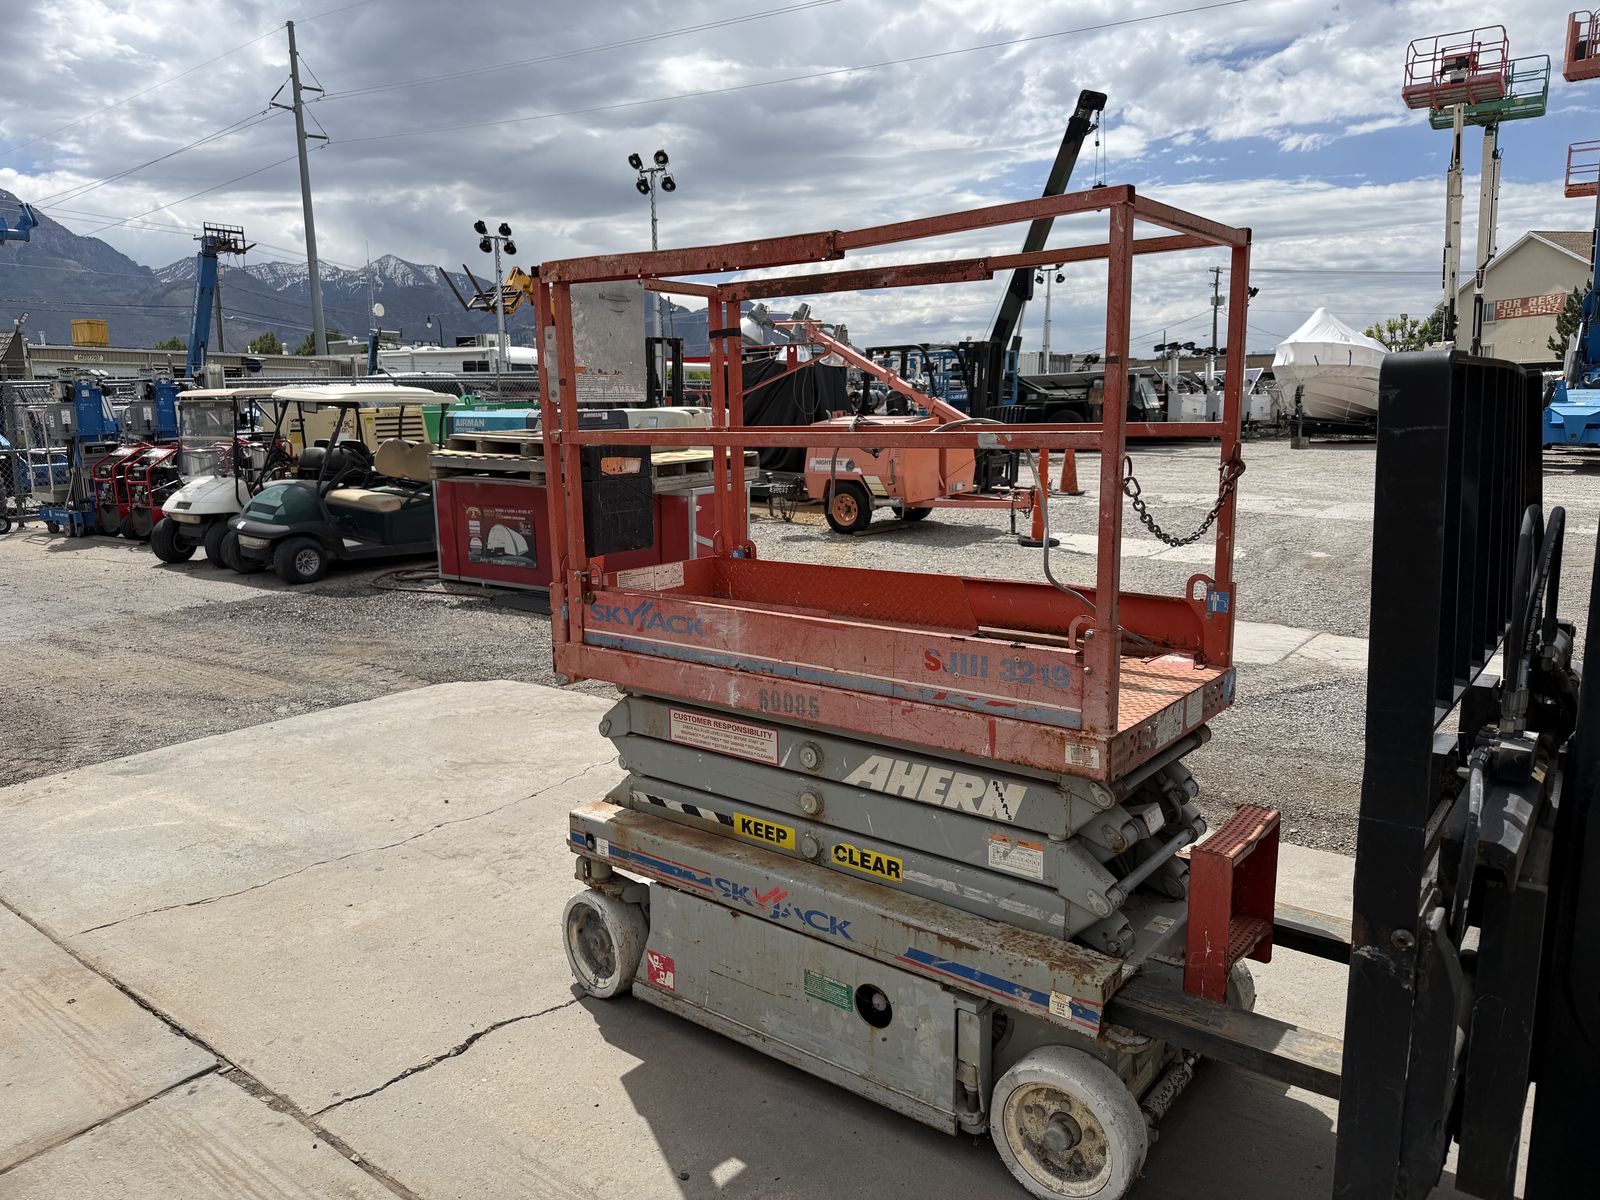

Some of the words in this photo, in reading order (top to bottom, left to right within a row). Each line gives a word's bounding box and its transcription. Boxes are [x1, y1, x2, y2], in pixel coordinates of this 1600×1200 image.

[1496, 299, 1521, 310] FOR
[455, 418, 485, 427] AIRMAN
[591, 599, 705, 638] SKYJACK
[1000, 658, 1070, 689] 3219
[673, 712, 712, 727] CUSTOMER
[713, 721, 773, 739] RESPONSIBILITY
[841, 754, 1028, 822] AHERN
[992, 780, 1013, 821] RENTALS
[741, 818, 788, 843] KEEP
[833, 845, 900, 879] CLEAR
[714, 877, 856, 942] SKYJACK
